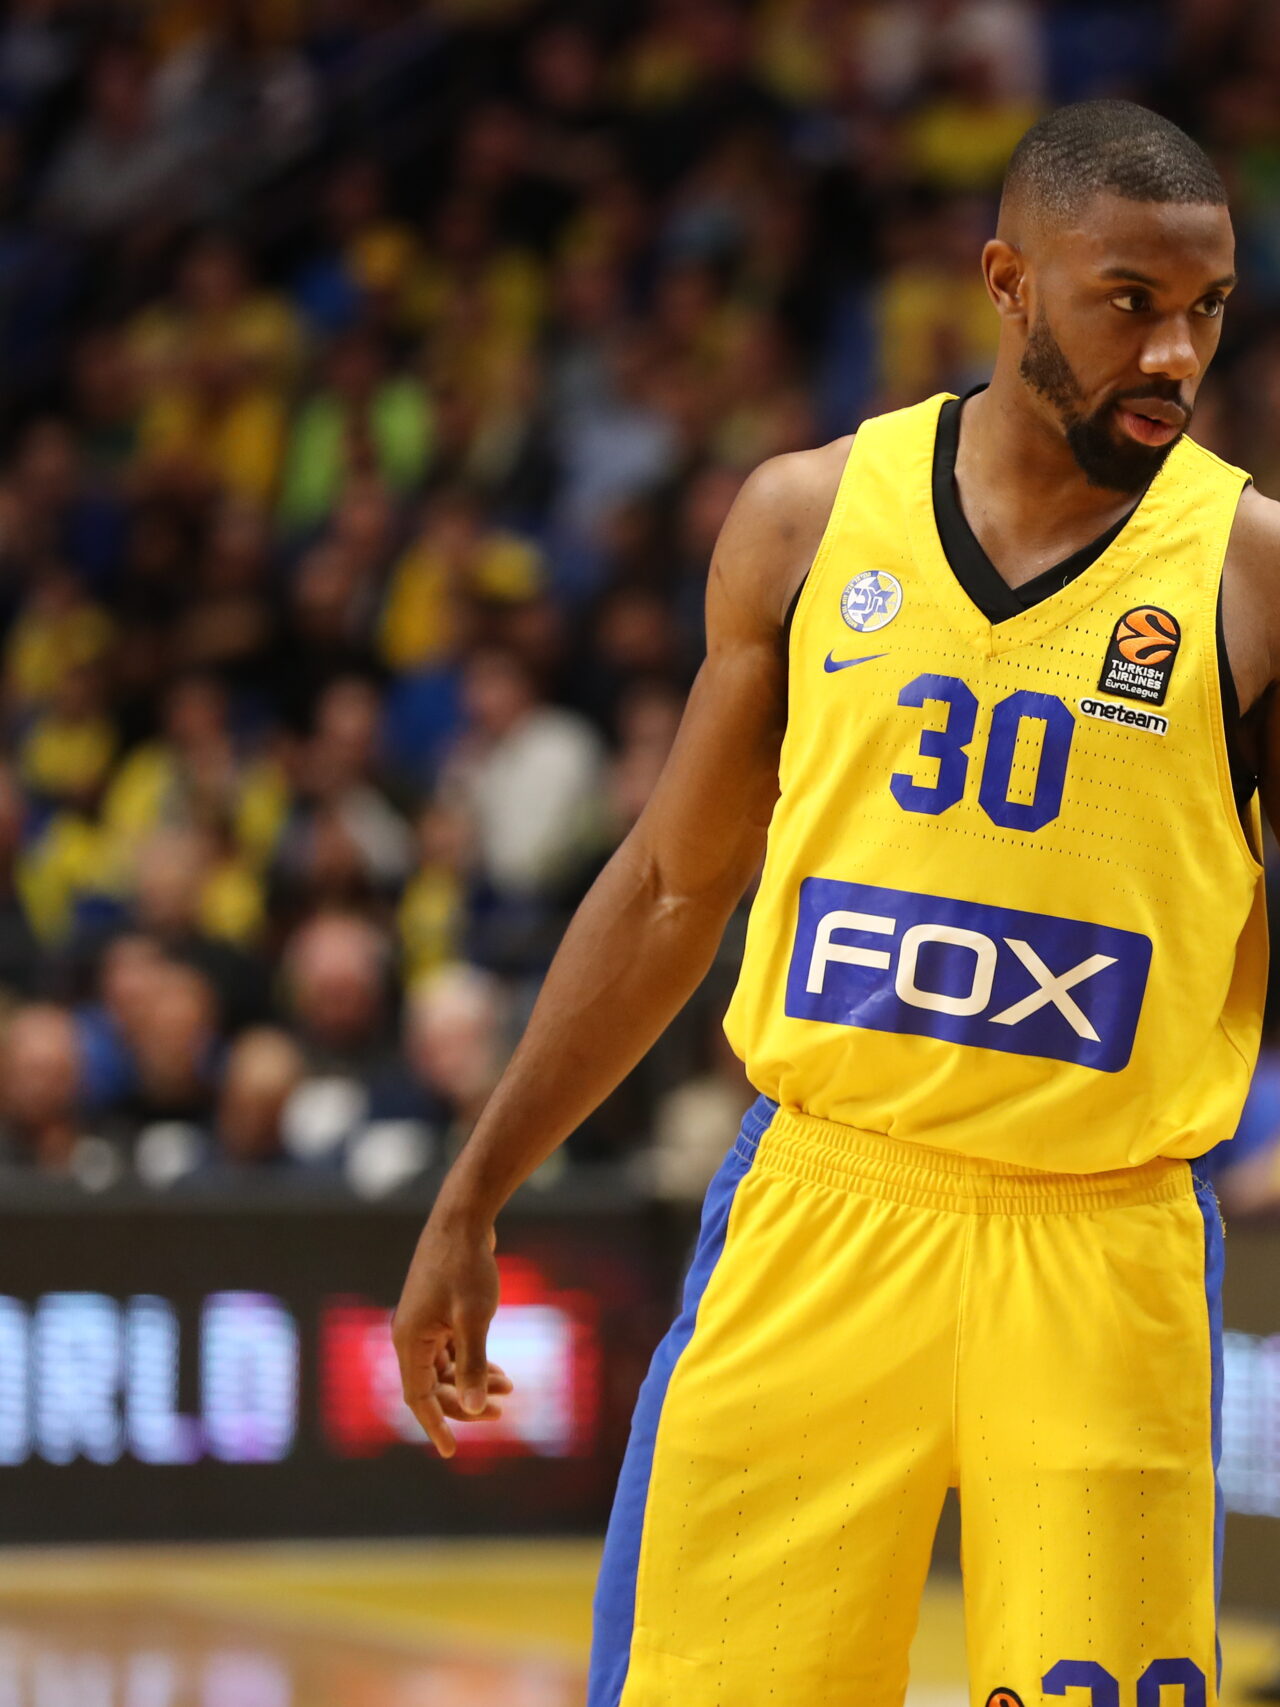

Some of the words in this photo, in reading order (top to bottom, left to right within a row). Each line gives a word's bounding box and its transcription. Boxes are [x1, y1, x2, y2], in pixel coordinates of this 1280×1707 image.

[1108, 669, 1161, 690] AIRLINES
[1111, 659, 1164, 681] TURKISH
[1105, 679, 1159, 699] EuroLeague
[1081, 699, 1167, 733] oneteam
[890, 673, 1075, 832] 30
[805, 910, 1119, 1042] FOX
